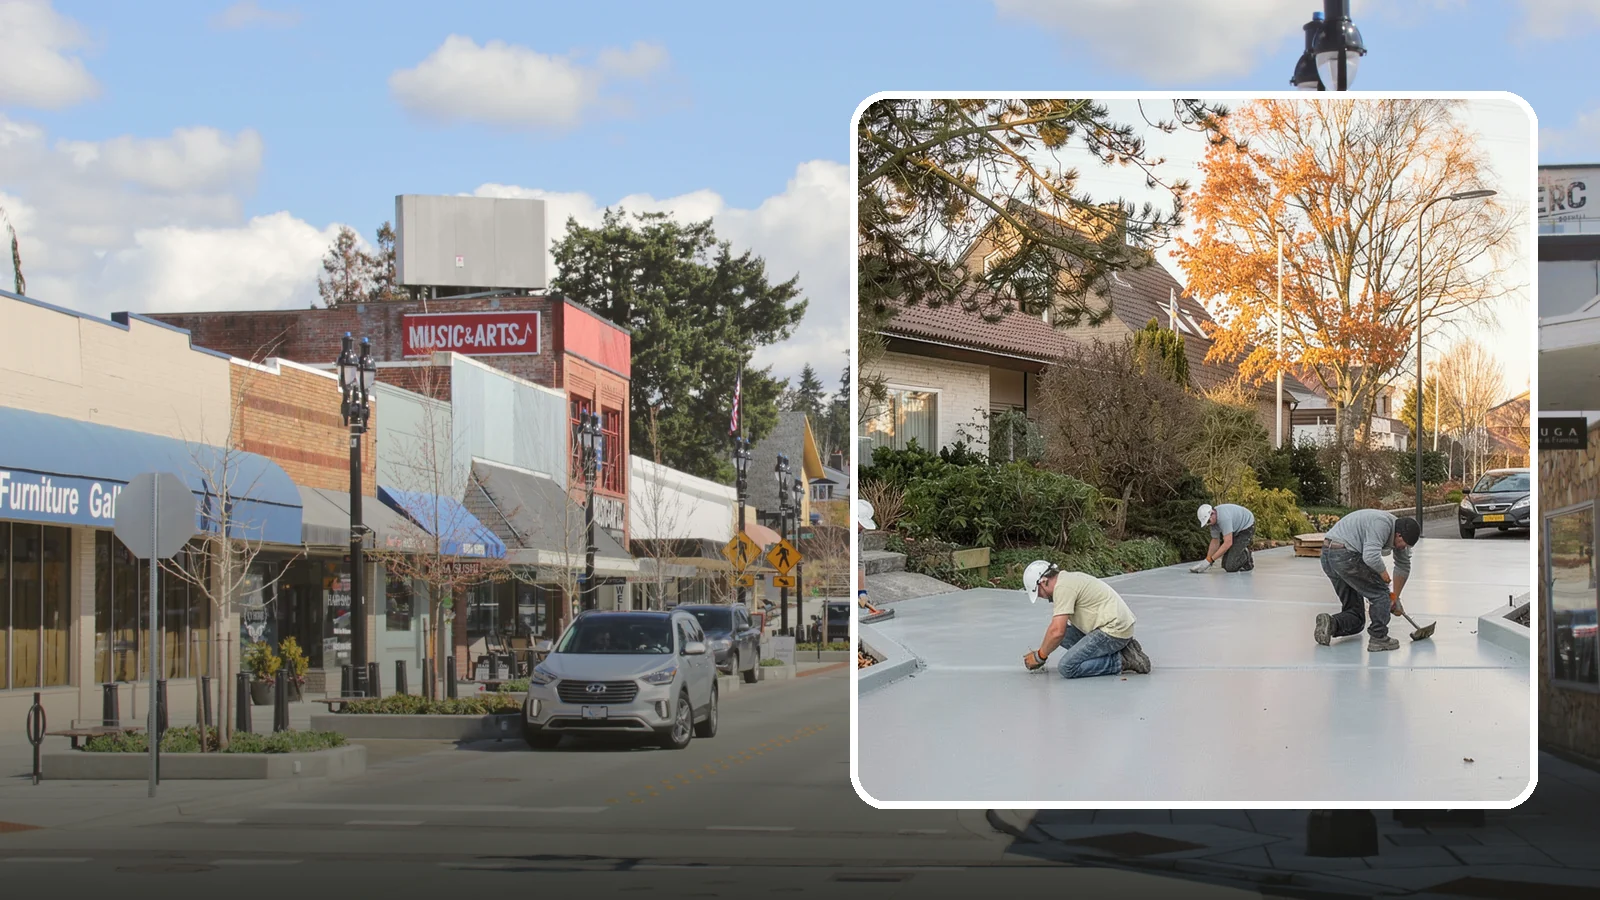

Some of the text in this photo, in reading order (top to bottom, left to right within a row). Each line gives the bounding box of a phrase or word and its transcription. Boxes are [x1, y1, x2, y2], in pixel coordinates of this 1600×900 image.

[1540, 427, 1578, 437] UGA
[1551, 436, 1579, 445] Framing
[0, 471, 122, 519] Furniture Gal
[453, 563, 480, 574] SUSHI
